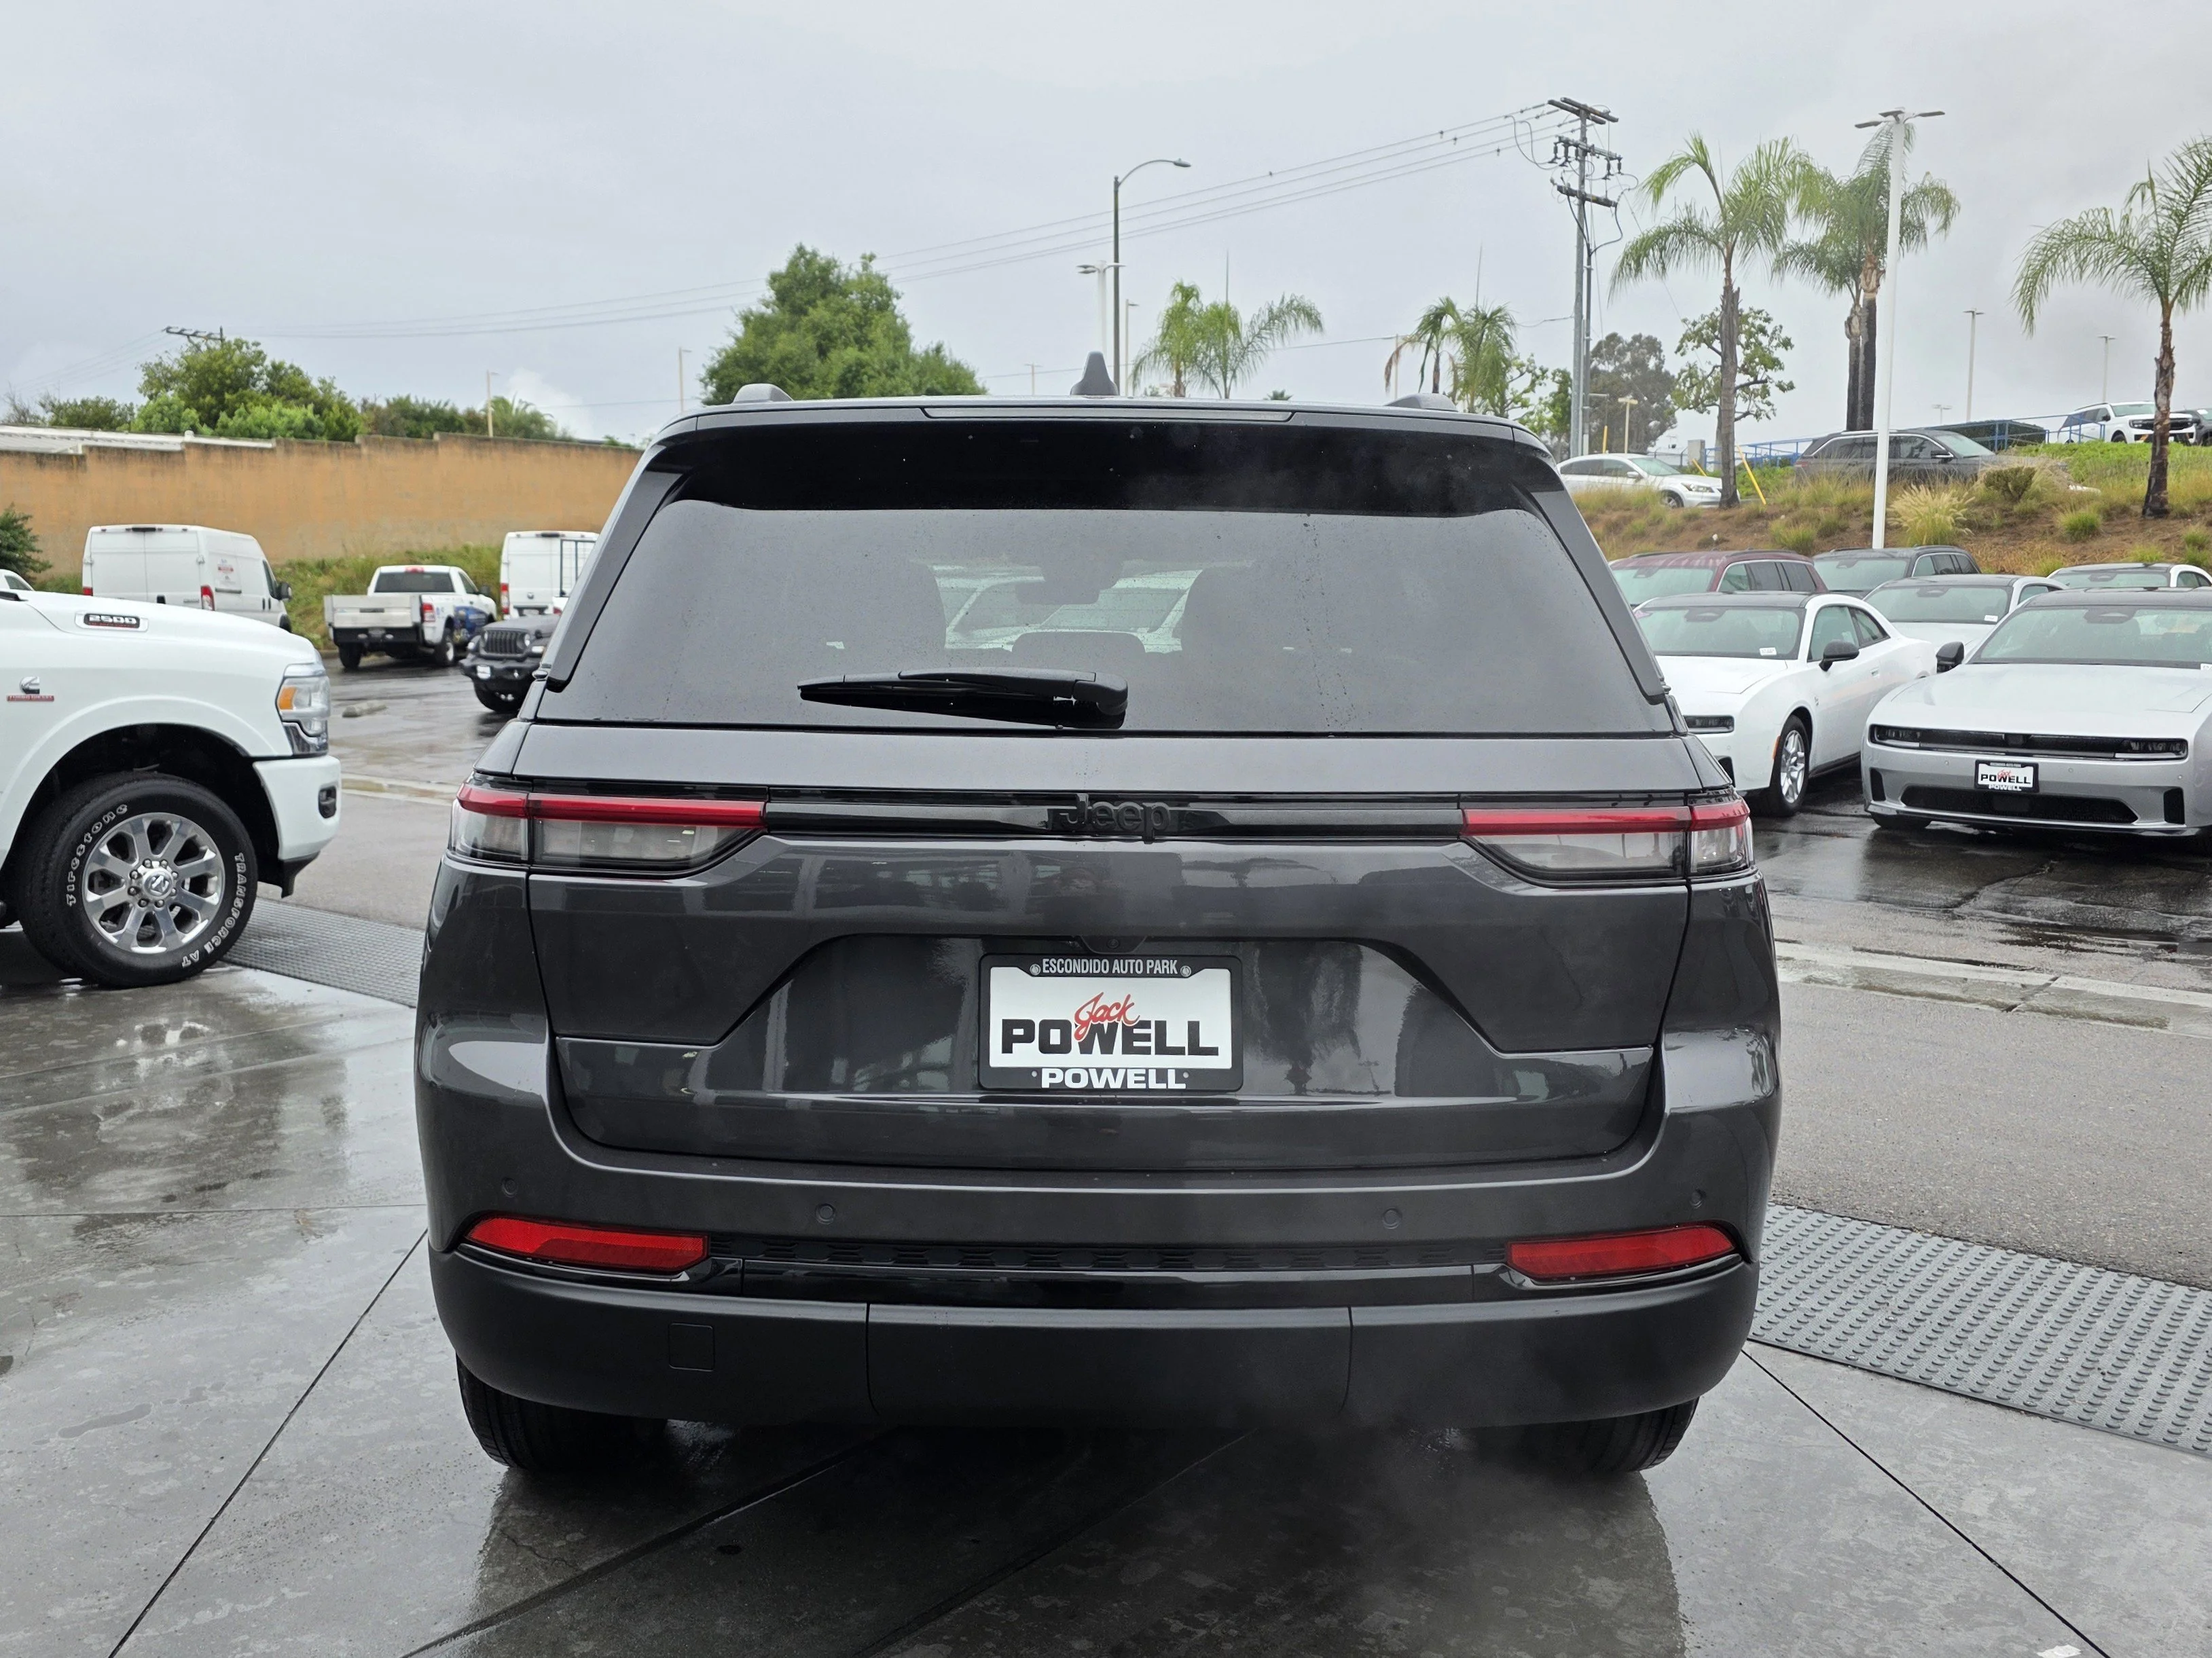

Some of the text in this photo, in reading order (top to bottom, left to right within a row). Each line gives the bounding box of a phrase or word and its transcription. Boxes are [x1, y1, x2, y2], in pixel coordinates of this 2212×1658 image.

[1980, 773, 2031, 785] POWELL
[1989, 784, 2022, 792] POWELL
[1059, 792, 1171, 845] Jeep
[66, 804, 128, 906] Firestone
[182, 852, 247, 968] TRANSFORCE AT
[1042, 958, 1178, 975] ESCONDIDO AUTO PARK
[1074, 991, 1140, 1042] Jack
[1001, 1018, 1219, 1056] POWELL
[1041, 1067, 1186, 1089] POWELL
